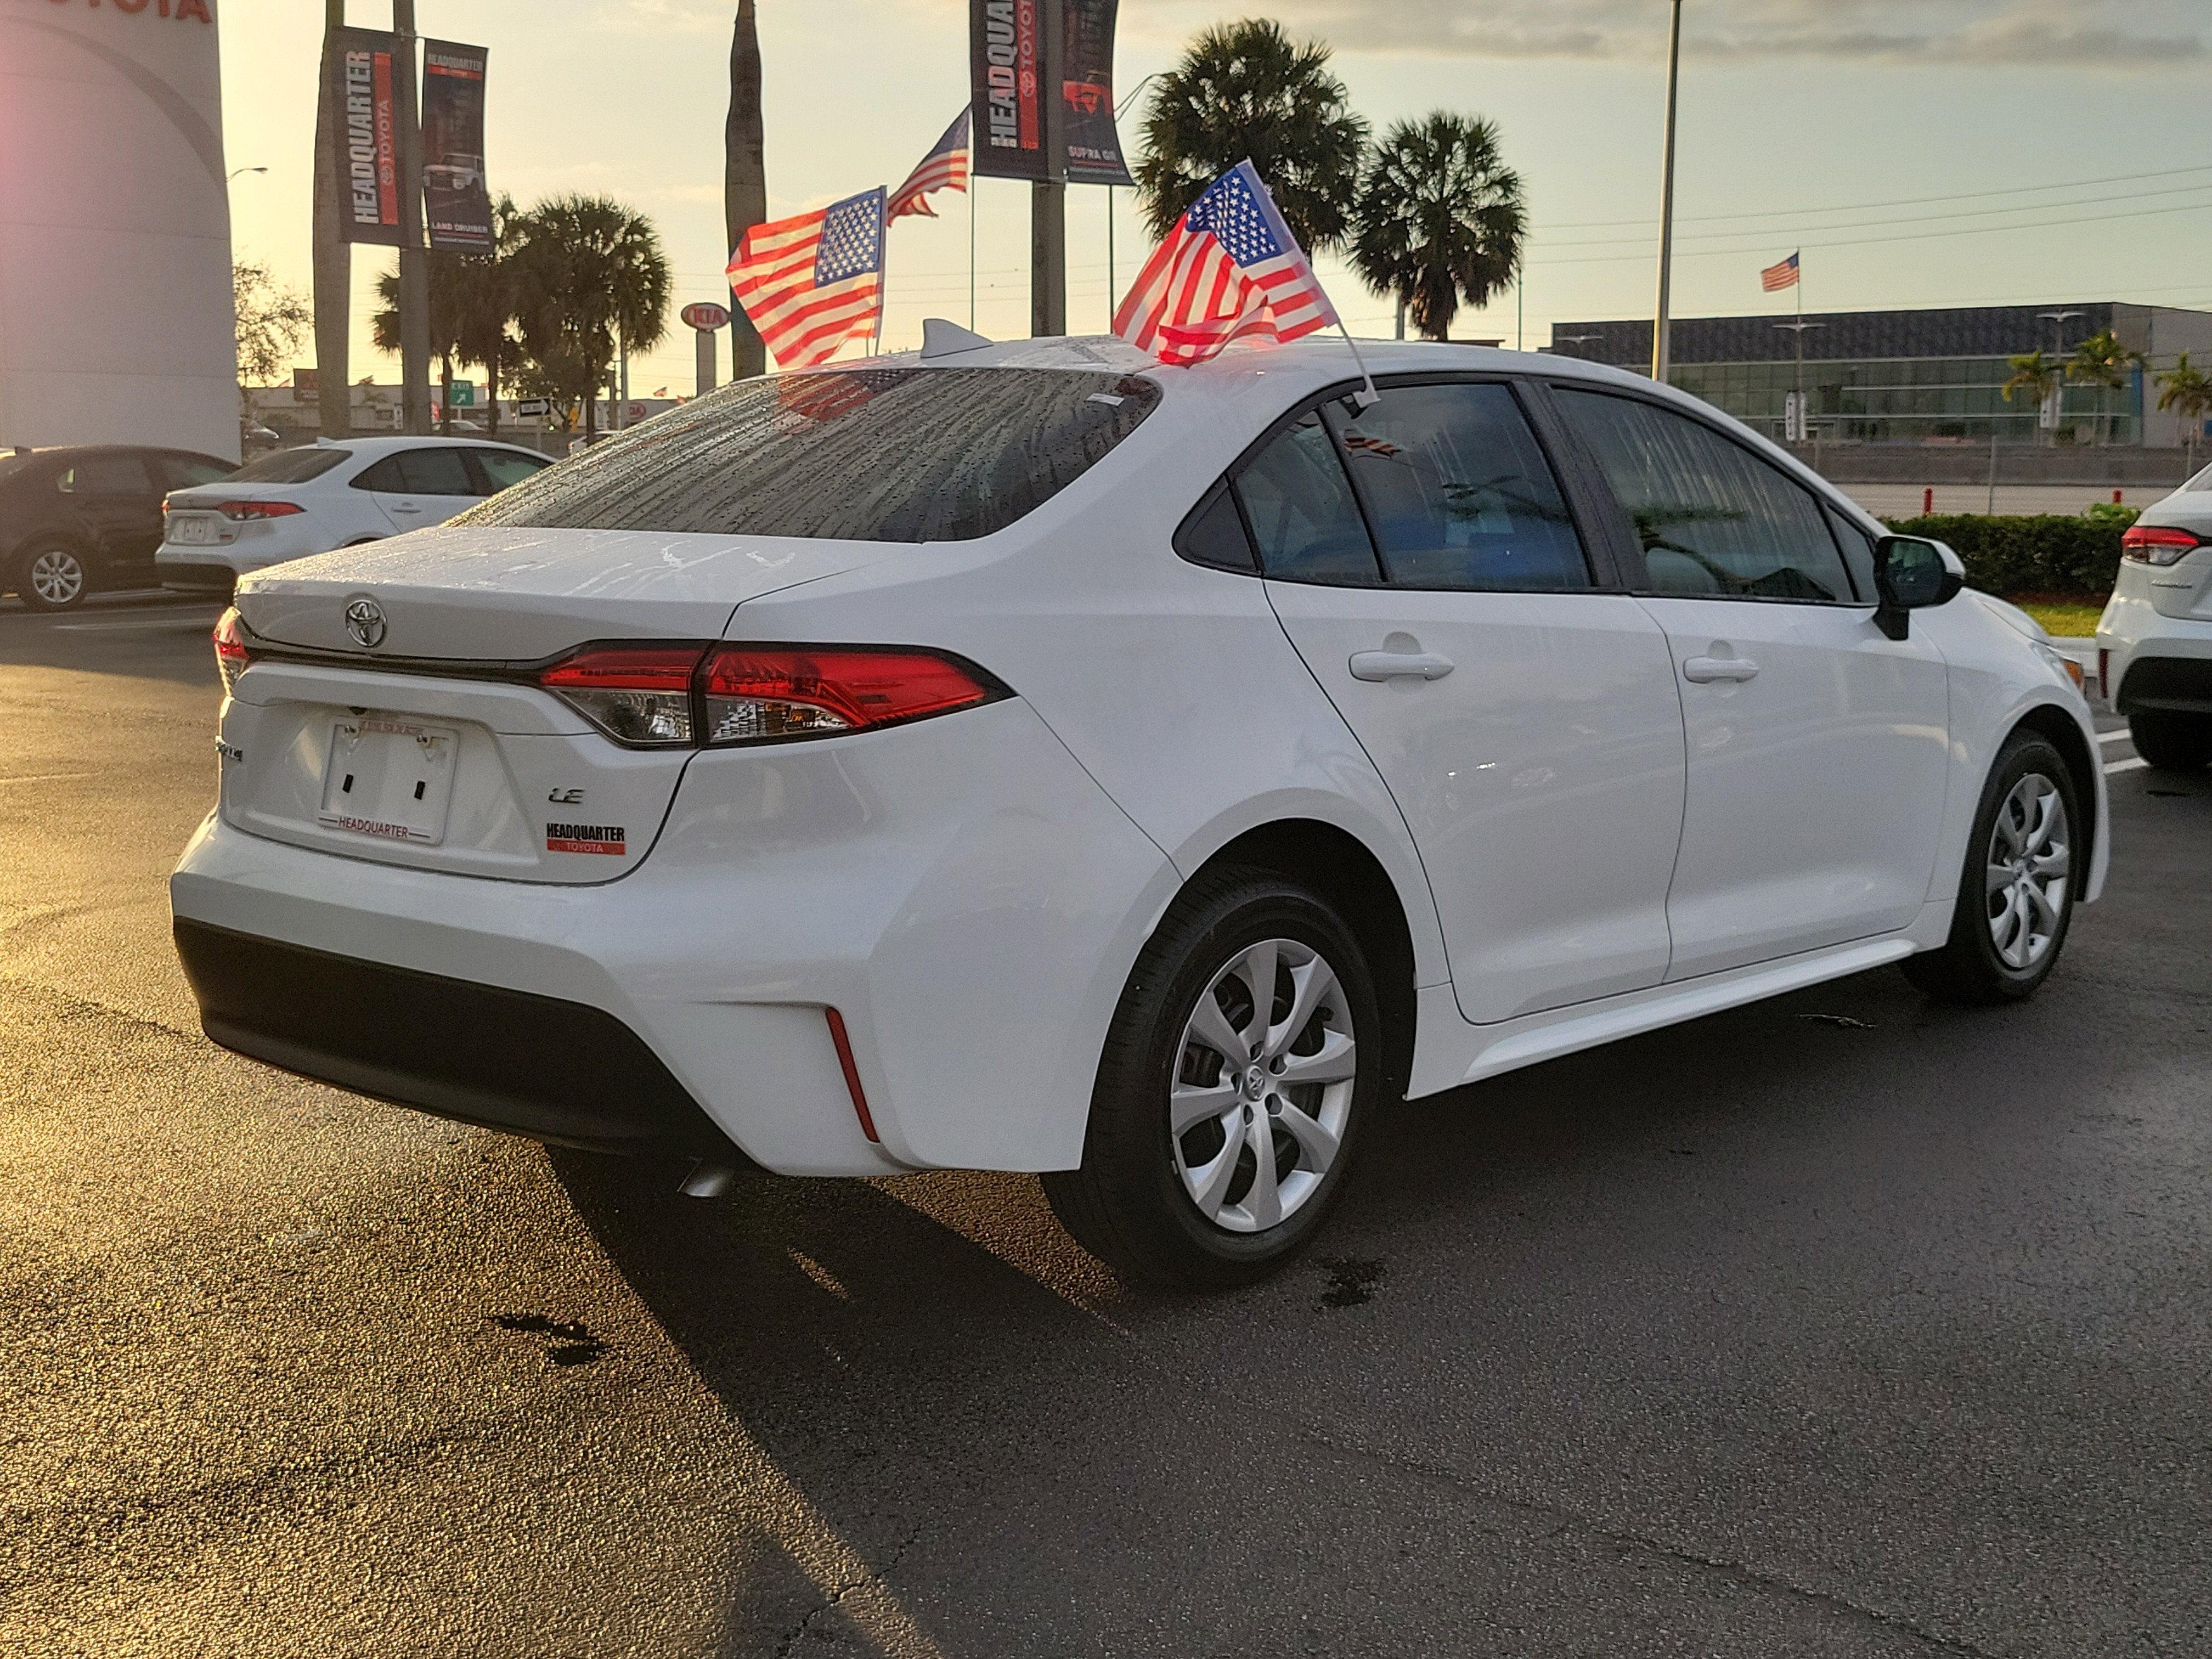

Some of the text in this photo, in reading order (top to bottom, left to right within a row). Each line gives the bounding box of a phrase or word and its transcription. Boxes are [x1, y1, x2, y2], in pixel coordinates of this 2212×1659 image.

[427, 54, 483, 72] HEADQUARTER
[346, 52, 379, 224] HEADQUARTER
[379, 100, 392, 161] TOYOTA
[1068, 145, 1102, 160] SUPRA
[431, 221, 488, 234] LAND CRUISER
[549, 788, 586, 804] LE
[338, 816, 408, 838] HEADQUARTER
[547, 823, 625, 842] HEADQUARTER
[566, 842, 604, 853] TOYOTA
